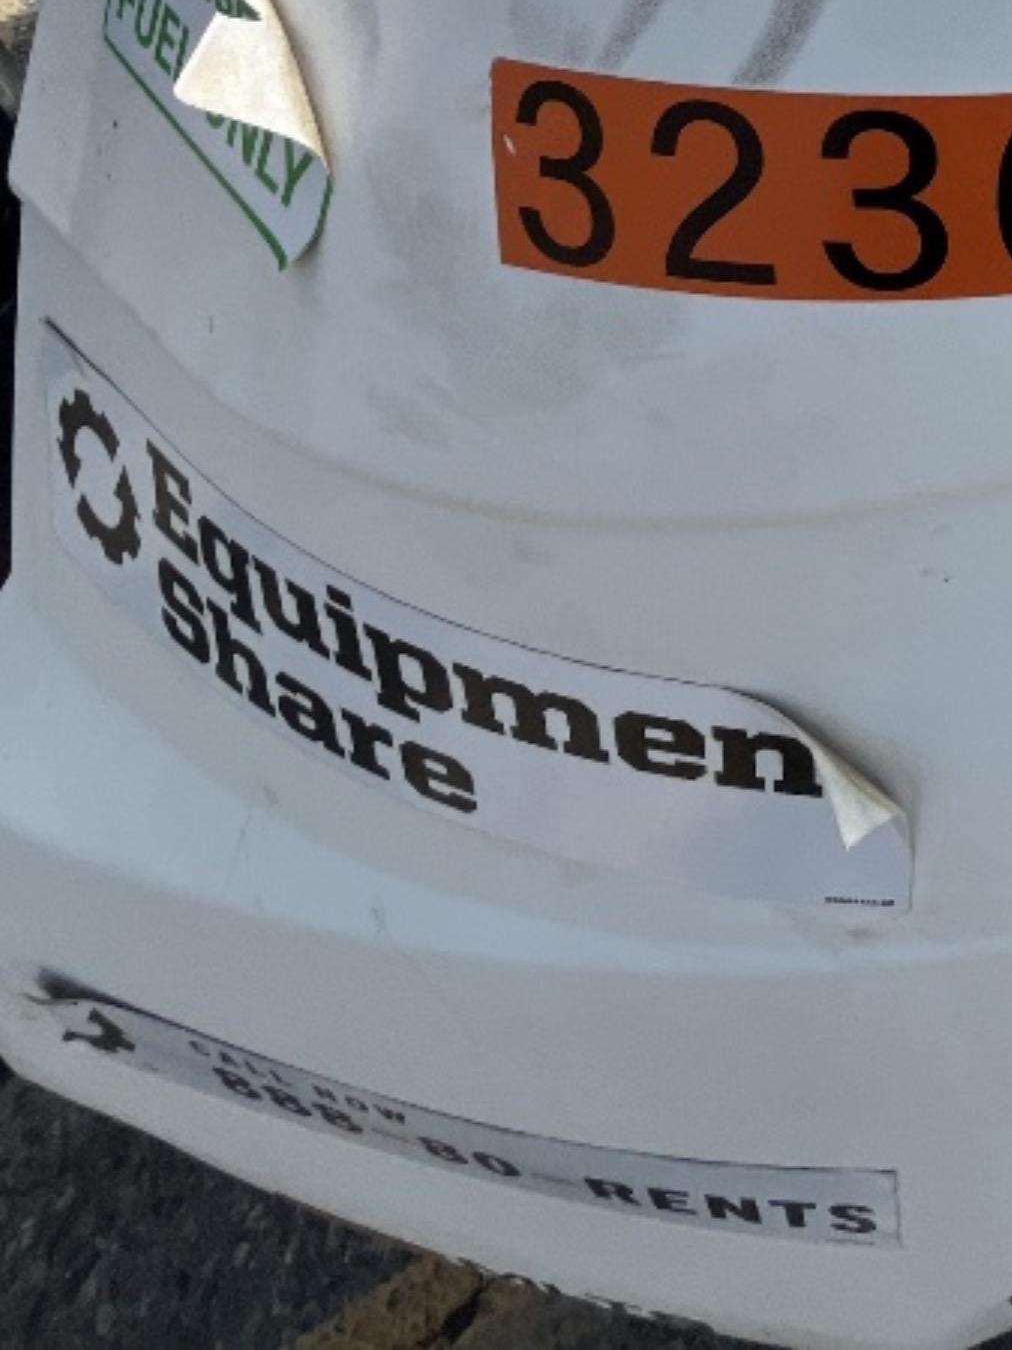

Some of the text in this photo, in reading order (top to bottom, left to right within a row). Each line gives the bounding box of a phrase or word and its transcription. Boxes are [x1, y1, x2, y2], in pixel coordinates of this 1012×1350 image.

[146, 439, 824, 798] Equipmen
[158, 557, 477, 814] Share
[188, 1039, 406, 1124] CALL NOW
